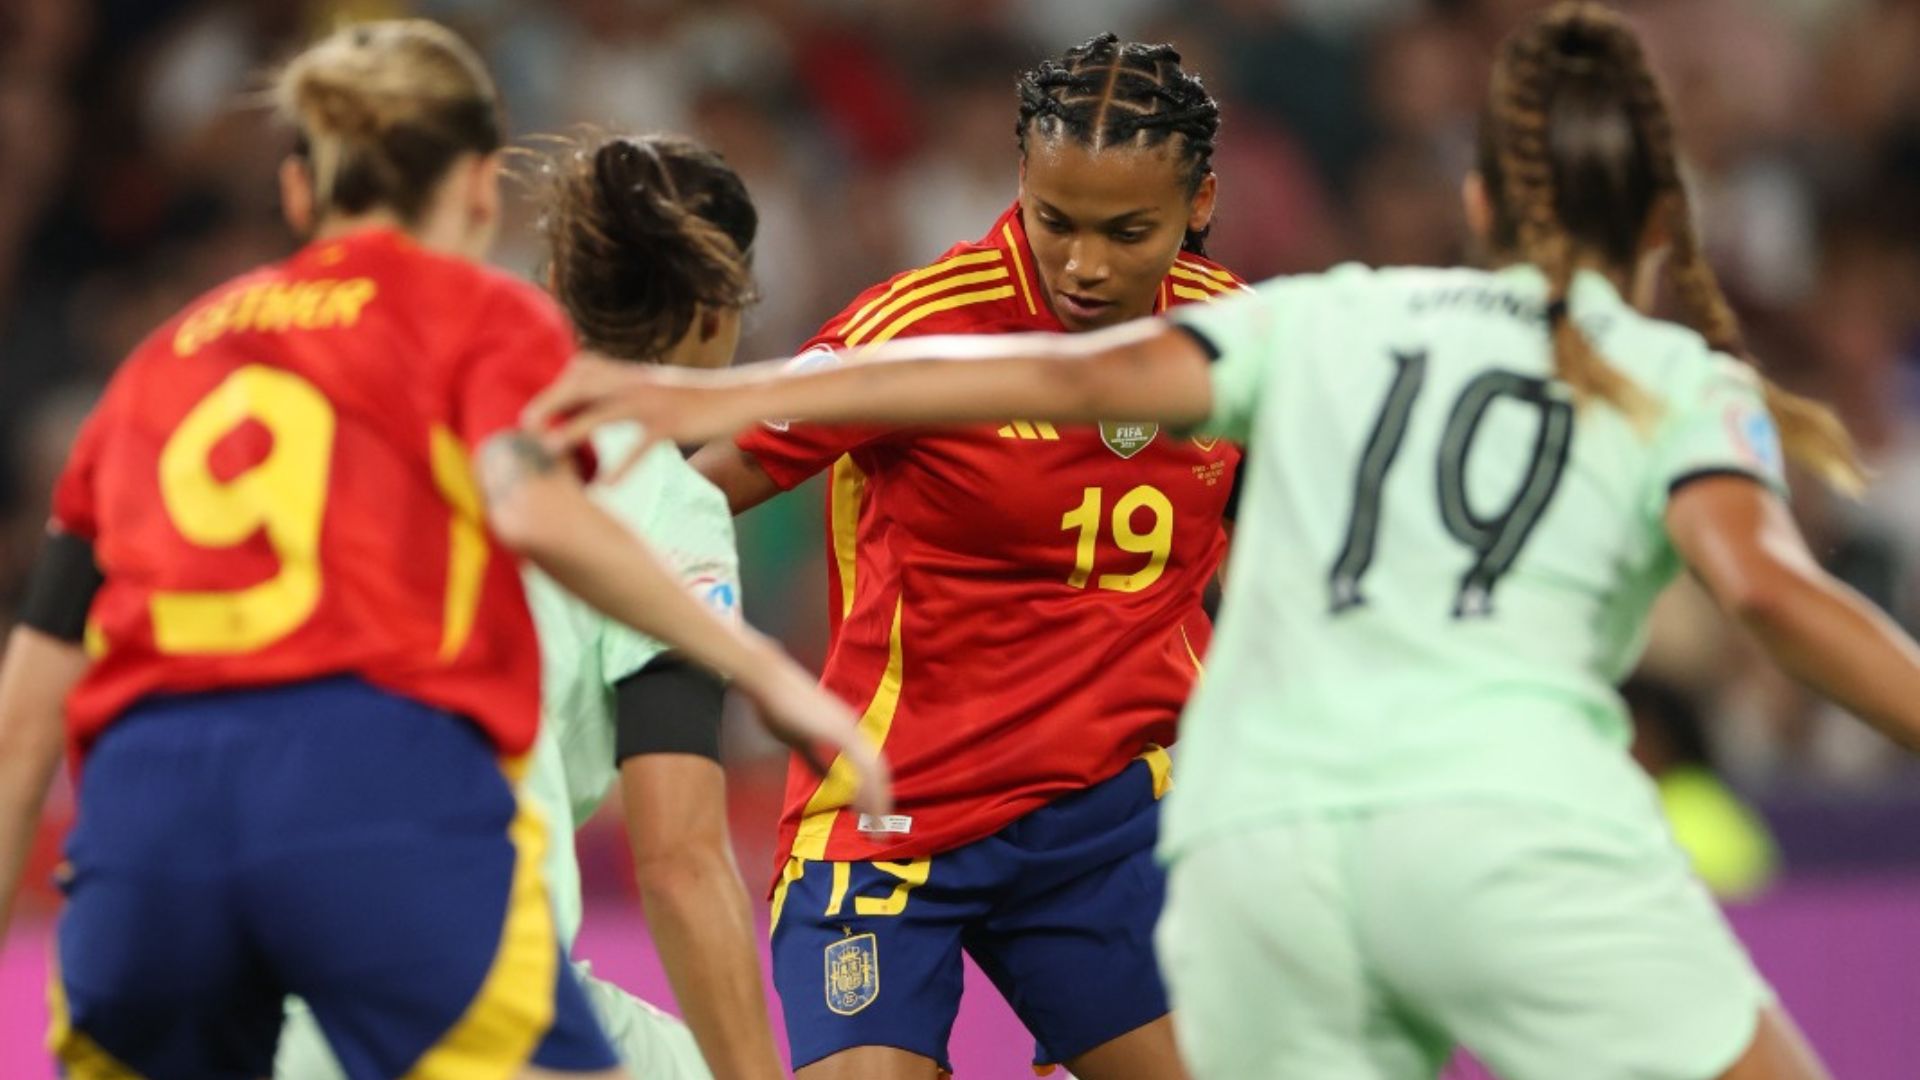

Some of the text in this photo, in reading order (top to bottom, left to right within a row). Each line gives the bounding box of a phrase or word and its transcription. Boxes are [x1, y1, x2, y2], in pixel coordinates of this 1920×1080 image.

[151, 364, 334, 653] 9
[1116, 426, 1142, 438] FIFA
[1328, 347, 1575, 619] 19
[1061, 485, 1173, 592] 19
